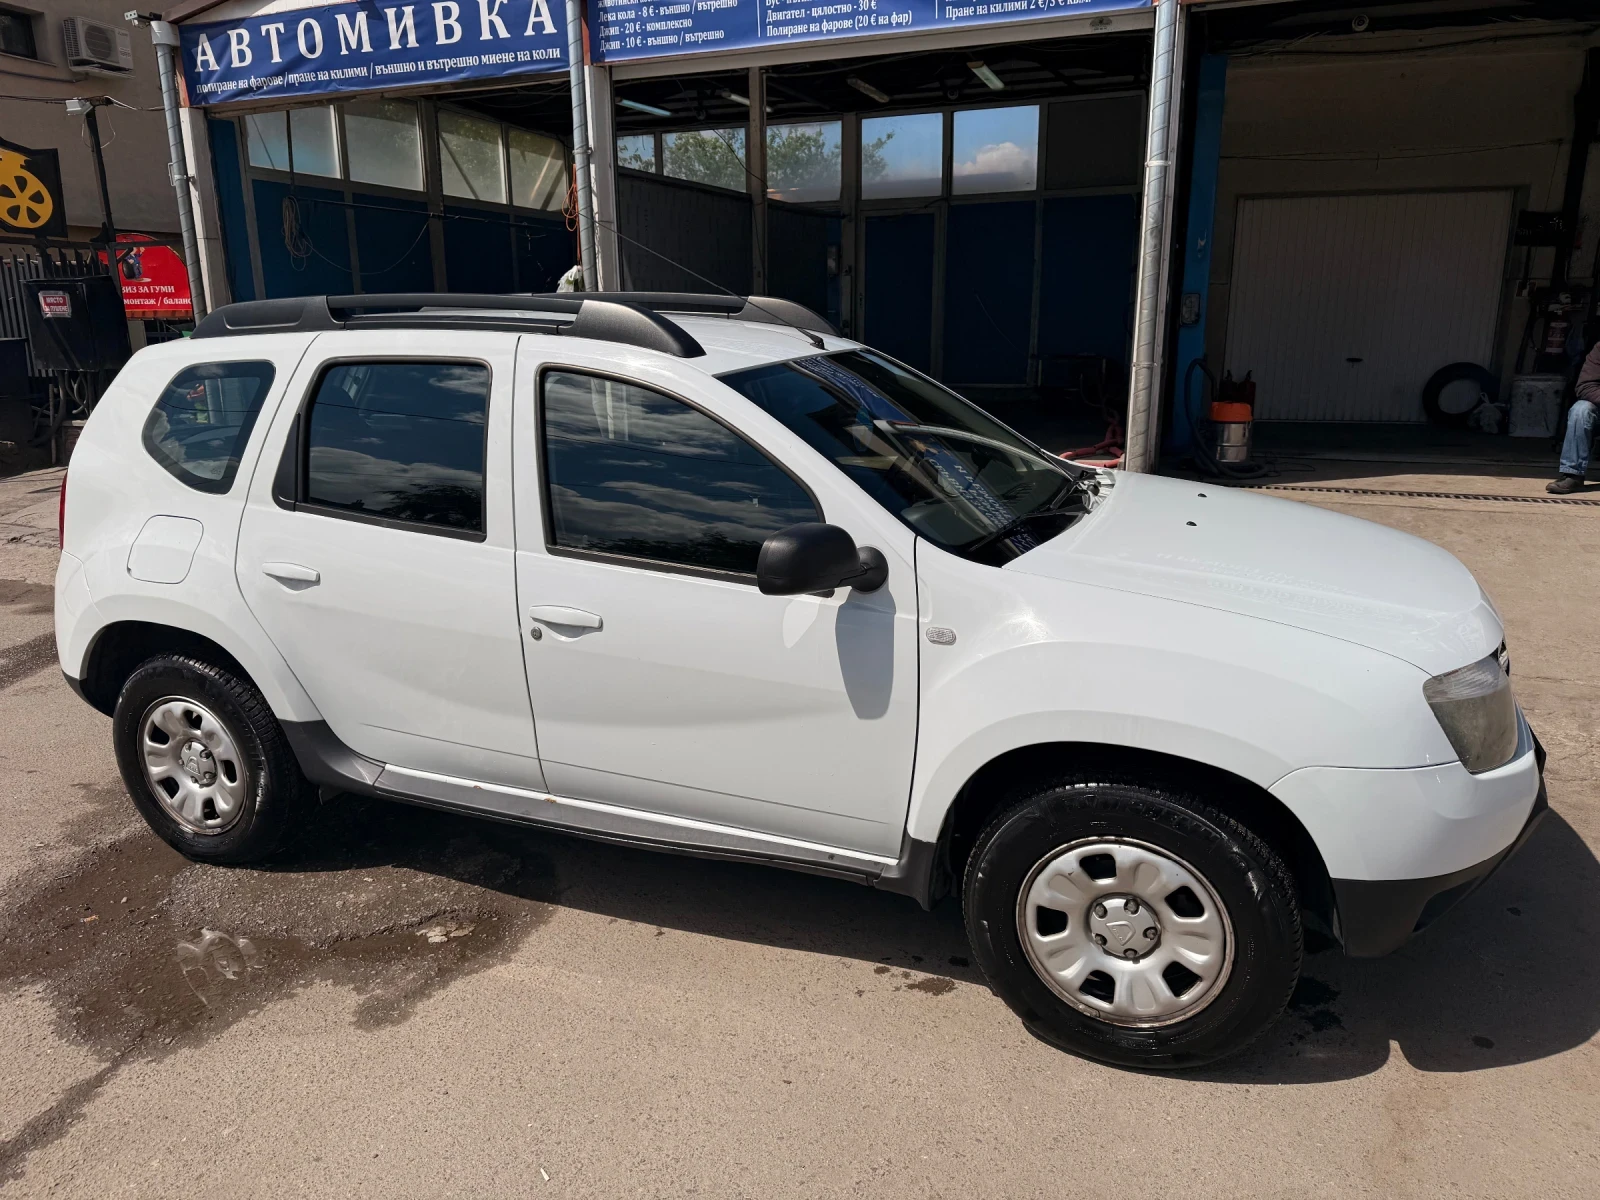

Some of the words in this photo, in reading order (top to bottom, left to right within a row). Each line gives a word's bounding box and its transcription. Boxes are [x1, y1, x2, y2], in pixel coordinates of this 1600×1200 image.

[598, 11, 616, 22] Лека
[617, 10, 635, 20] кола
[642, 6, 648, 17] 8
[649, 5, 655, 16] €
[659, 4, 690, 15] външно
[697, 0, 738, 12] вътрешно
[766, 9, 805, 24] Двигател
[812, 3, 852, 18] цялостно
[859, 0, 869, 11] 30
[871, 0, 877, 10] €
[946, 6, 974, 20] Пране
[977, 5, 988, 15] на
[990, 1, 1027, 13] килими
[599, 26, 620, 39] Джип
[625, 22, 635, 34] 20
[636, 22, 641, 33] €
[646, 18, 692, 31] комплексно
[767, 24, 808, 37] Полиране
[810, 24, 819, 32] на
[822, 19, 853, 33] фарове
[855, 16, 869, 30] (20
[871, 14, 877, 25] €
[878, 15, 889, 24] на
[891, 11, 912, 26] фар)
[195, 0, 557, 72] АВТОМИВКА
[600, 40, 620, 53] Джип
[626, 37, 635, 48] 10
[636, 36, 642, 47] €
[647, 35, 678, 46] външно
[685, 30, 724, 43] вътрешно
[196, 81, 238, 94] полиране
[238, 80, 248, 89] на
[250, 75, 283, 89] фарове
[317, 71, 328, 80] на
[330, 67, 368, 79] килими
[375, 61, 416, 75] външно
[417, 62, 425, 71] и
[427, 55, 478, 71] вътрешно
[481, 52, 515, 65] миене
[517, 51, 531, 61] на
[533, 48, 560, 59] коли
